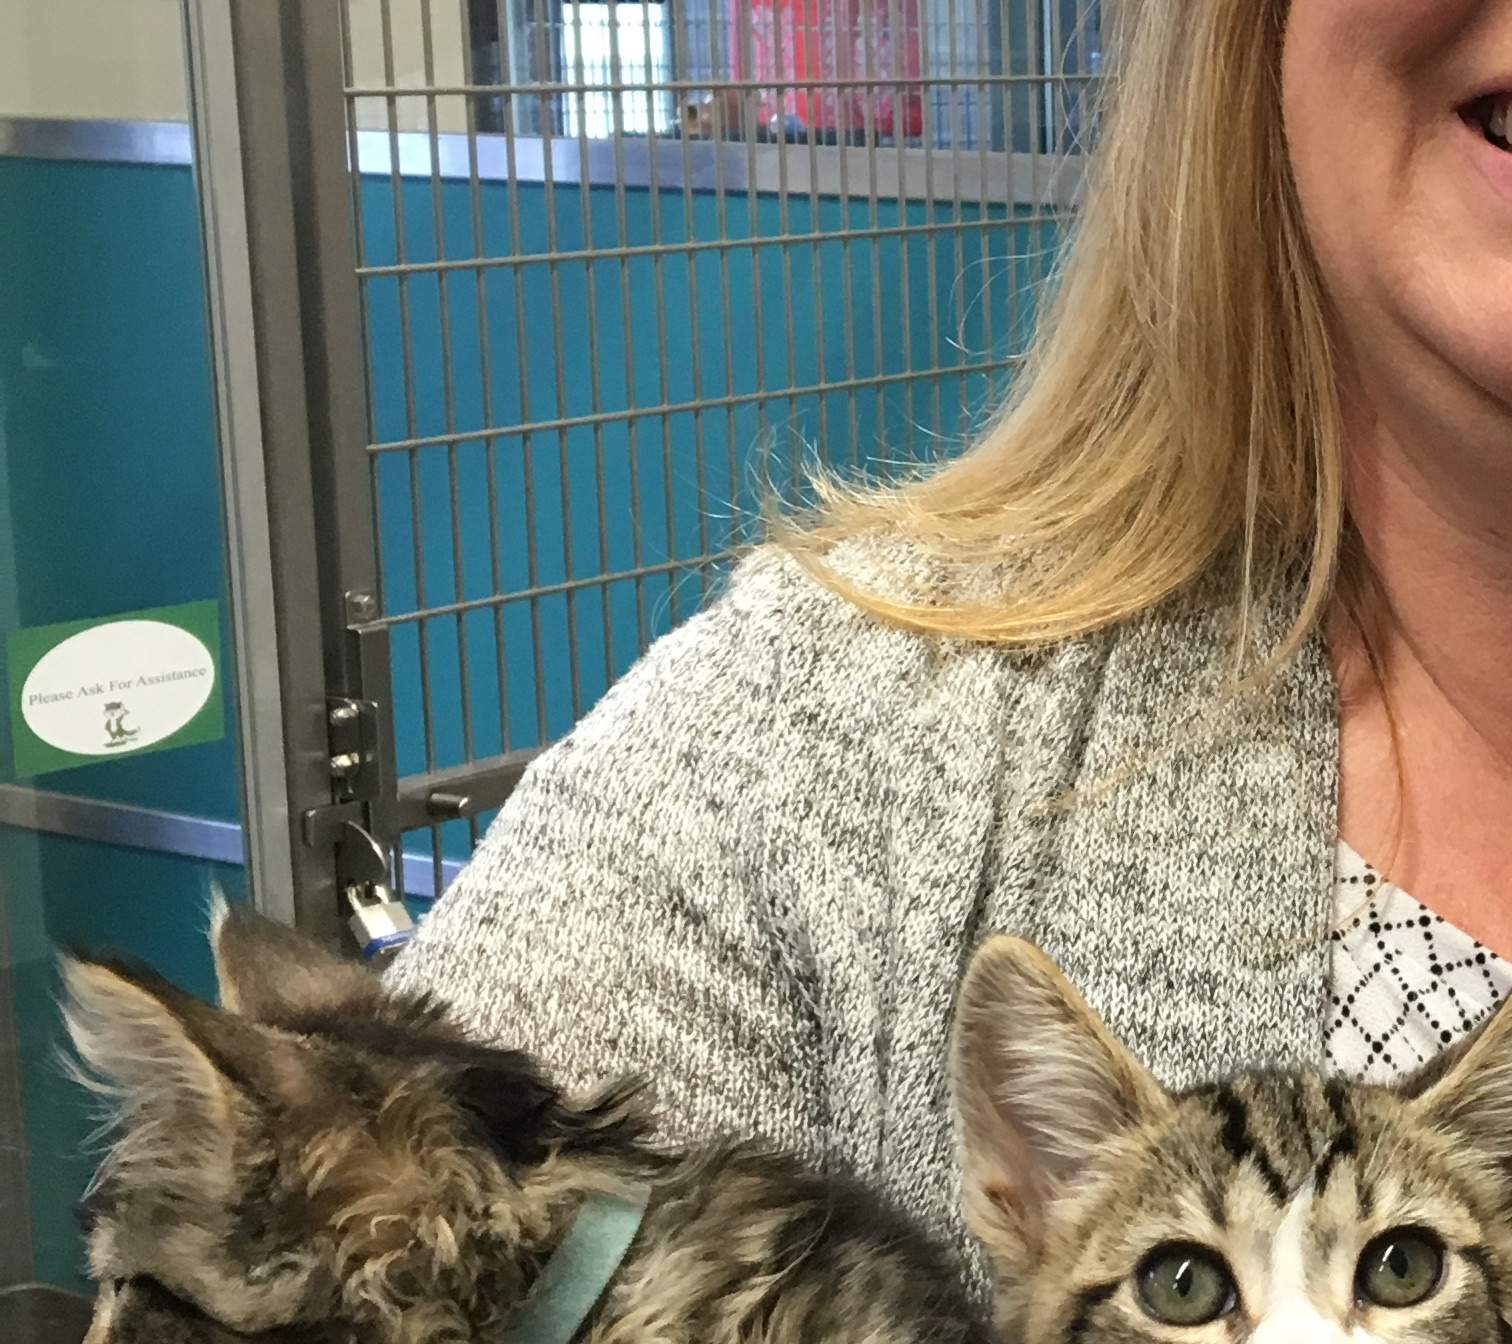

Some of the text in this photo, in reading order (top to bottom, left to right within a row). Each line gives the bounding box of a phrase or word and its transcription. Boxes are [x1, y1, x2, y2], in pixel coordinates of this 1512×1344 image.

[29, 668, 208, 706] Please Ask For Assistance
